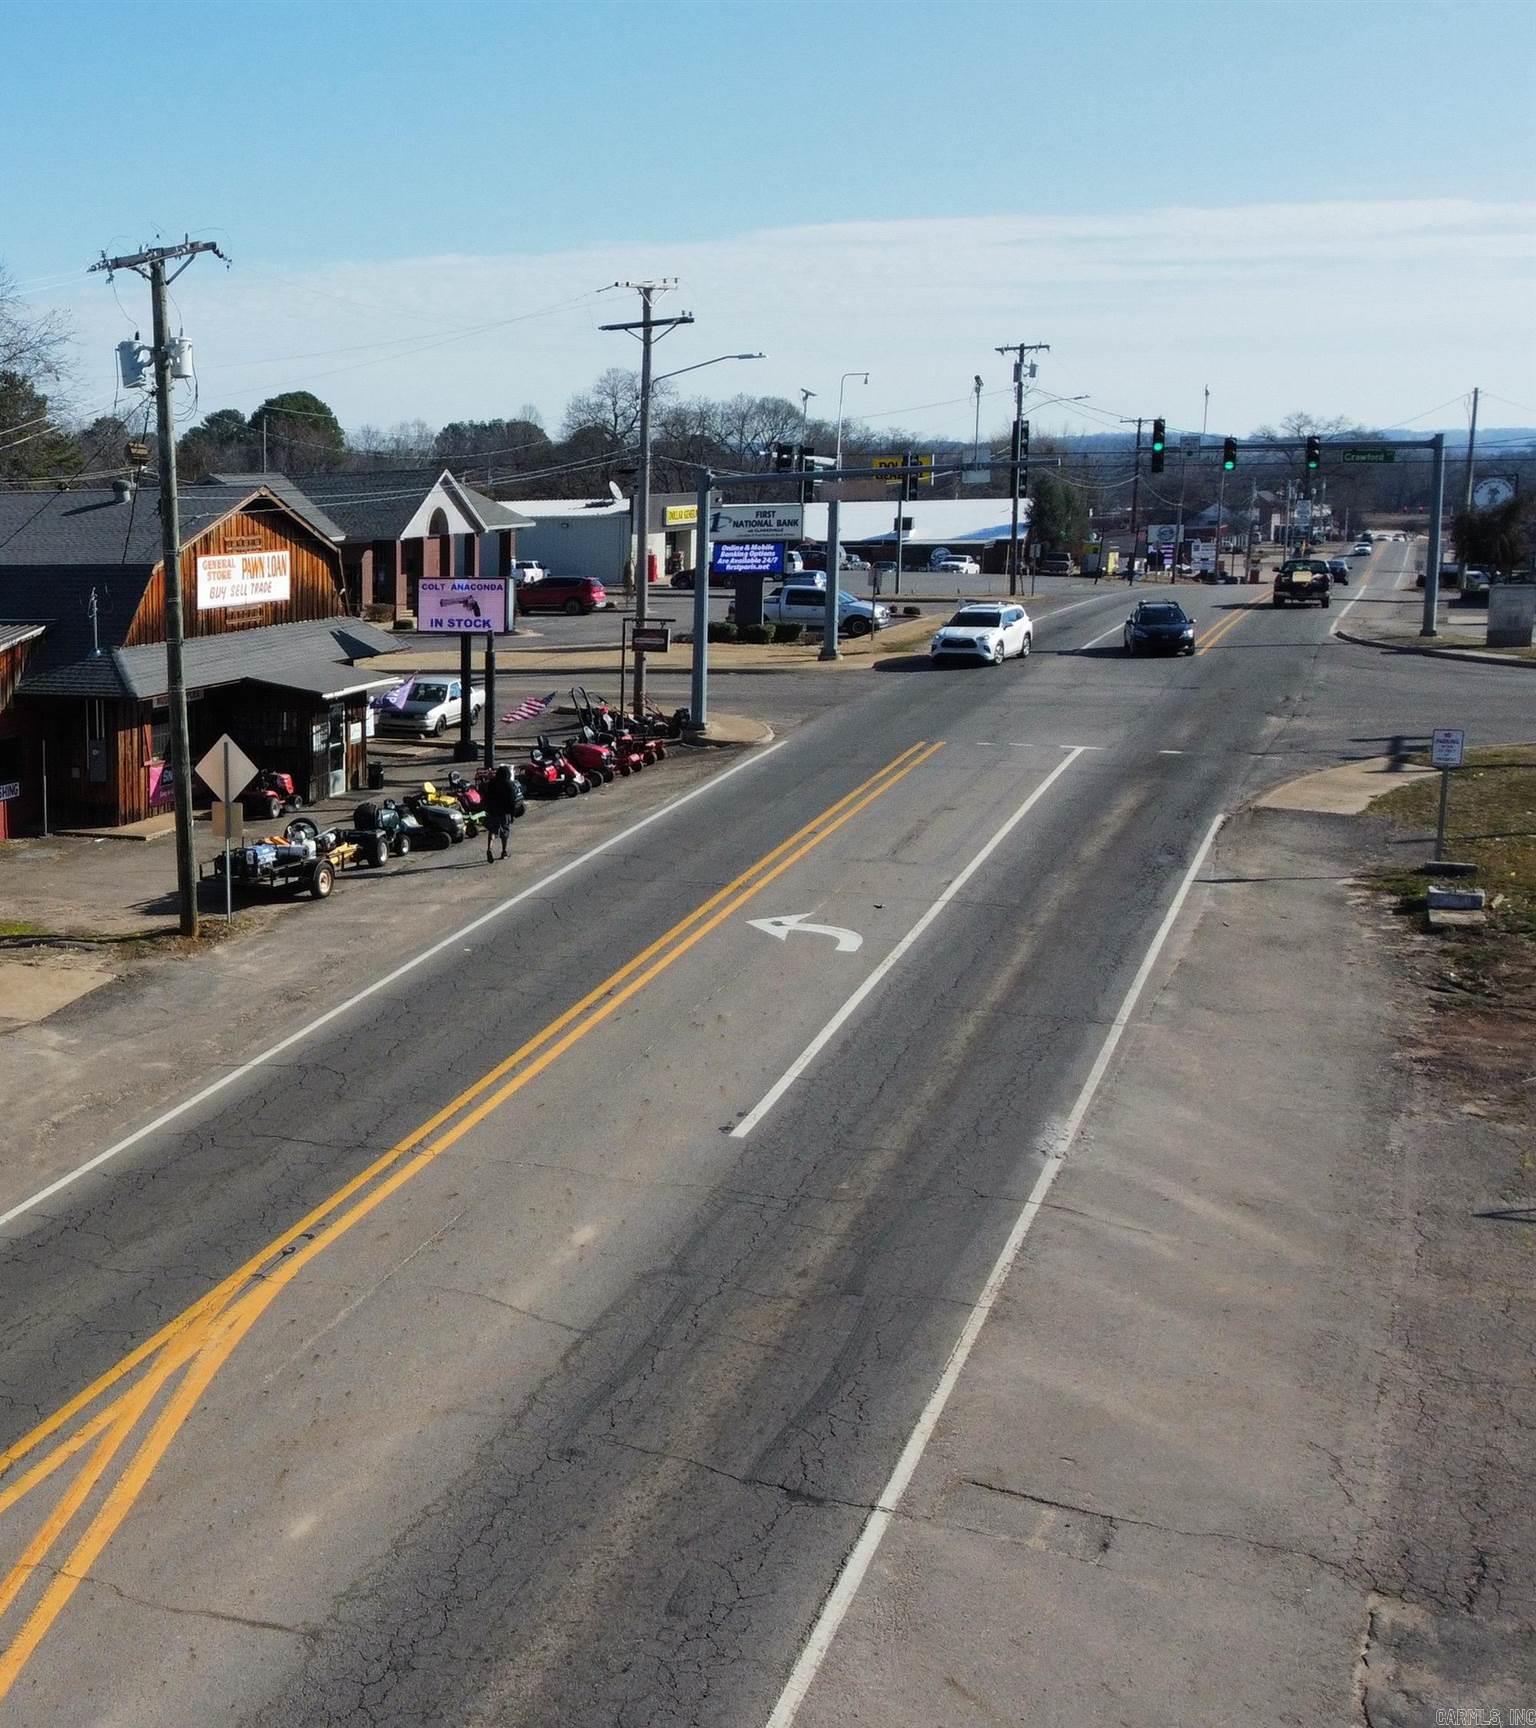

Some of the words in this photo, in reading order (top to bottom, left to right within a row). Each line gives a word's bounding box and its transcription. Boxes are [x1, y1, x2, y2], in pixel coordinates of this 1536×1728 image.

[755, 510, 776, 519] FIRST
[732, 519, 773, 528] NATIONAL
[776, 518, 799, 527] BANK
[751, 543, 775, 551] Mobile
[720, 551, 748, 559] Banking
[749, 550, 776, 558] Options
[201, 558, 237, 571] GENERAL
[241, 556, 265, 581] PAWN
[267, 553, 288, 577] LOAN
[207, 570, 233, 581] STORE
[209, 586, 227, 600] BUY
[230, 583, 248, 597] SELL
[250, 580, 273, 594] TRADE
[421, 583, 446, 591] COLT
[450, 583, 504, 591] ANACONDA
[430, 618, 444, 628] IN
[447, 618, 492, 629] STOCK
